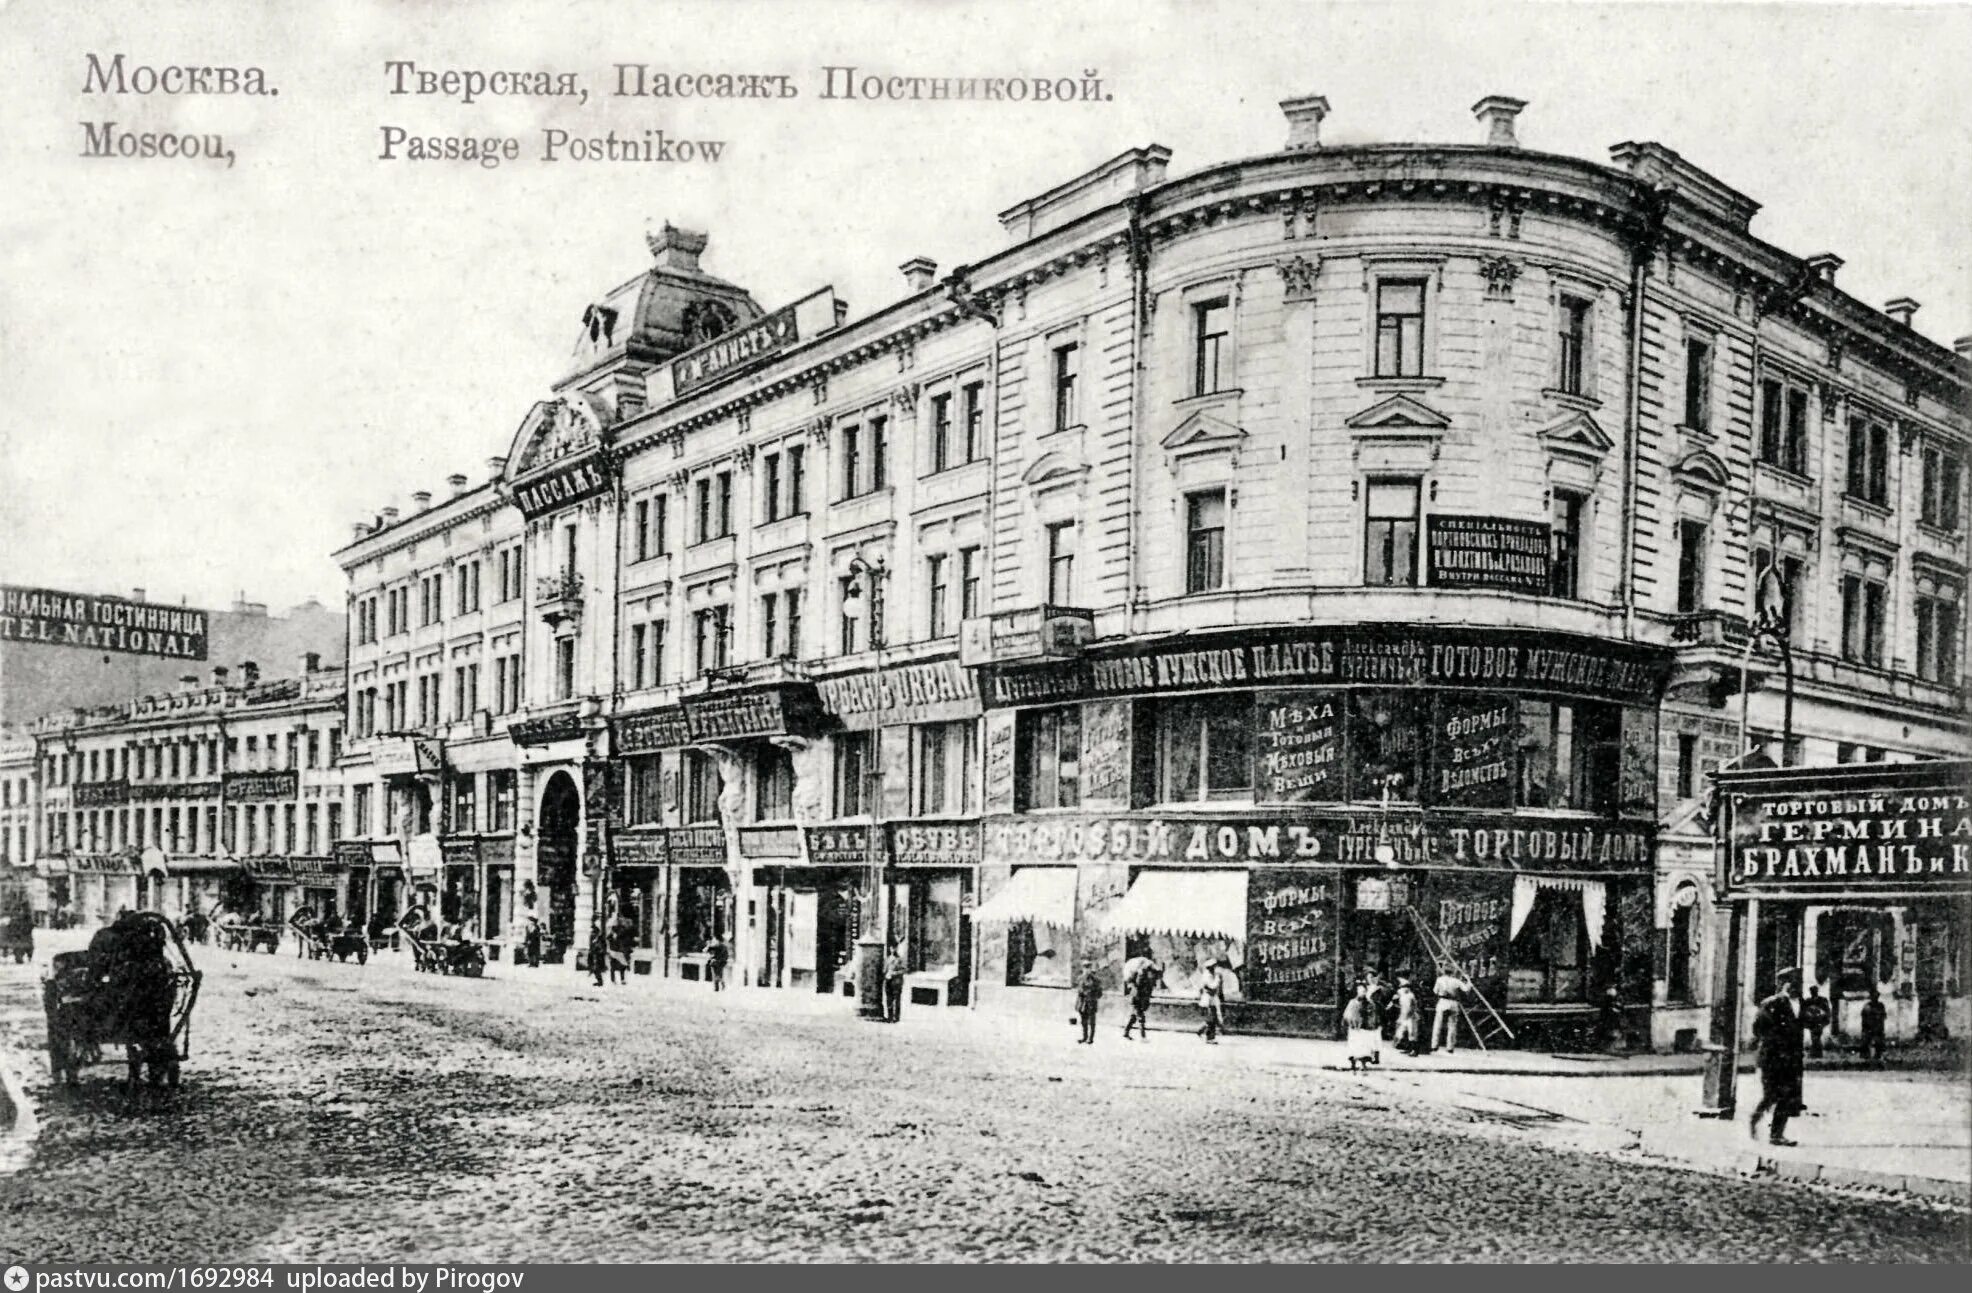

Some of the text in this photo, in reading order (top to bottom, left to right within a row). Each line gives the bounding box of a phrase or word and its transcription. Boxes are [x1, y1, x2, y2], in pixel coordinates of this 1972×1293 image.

[519, 464, 602, 513] ПАССАЖЪ
[93, 601, 203, 636] ГОСТИННИЦА
[62, 622, 196, 657] NATIONAL
[1155, 647, 1247, 687] МУЖСКОЕ
[1252, 641, 1335, 678] ПЛАТЬЕ
[1432, 644, 1518, 679] ГОТОВОЕ
[897, 659, 979, 706] URBAN
[1185, 825, 1321, 861] ДОМЪ
[1450, 826, 1648, 863] ТОРГОВЫЙ ДОМЪ
[1758, 817, 1972, 843] ГЕРМИНА
[1743, 845, 1923, 877] БРАХМАНЪ
